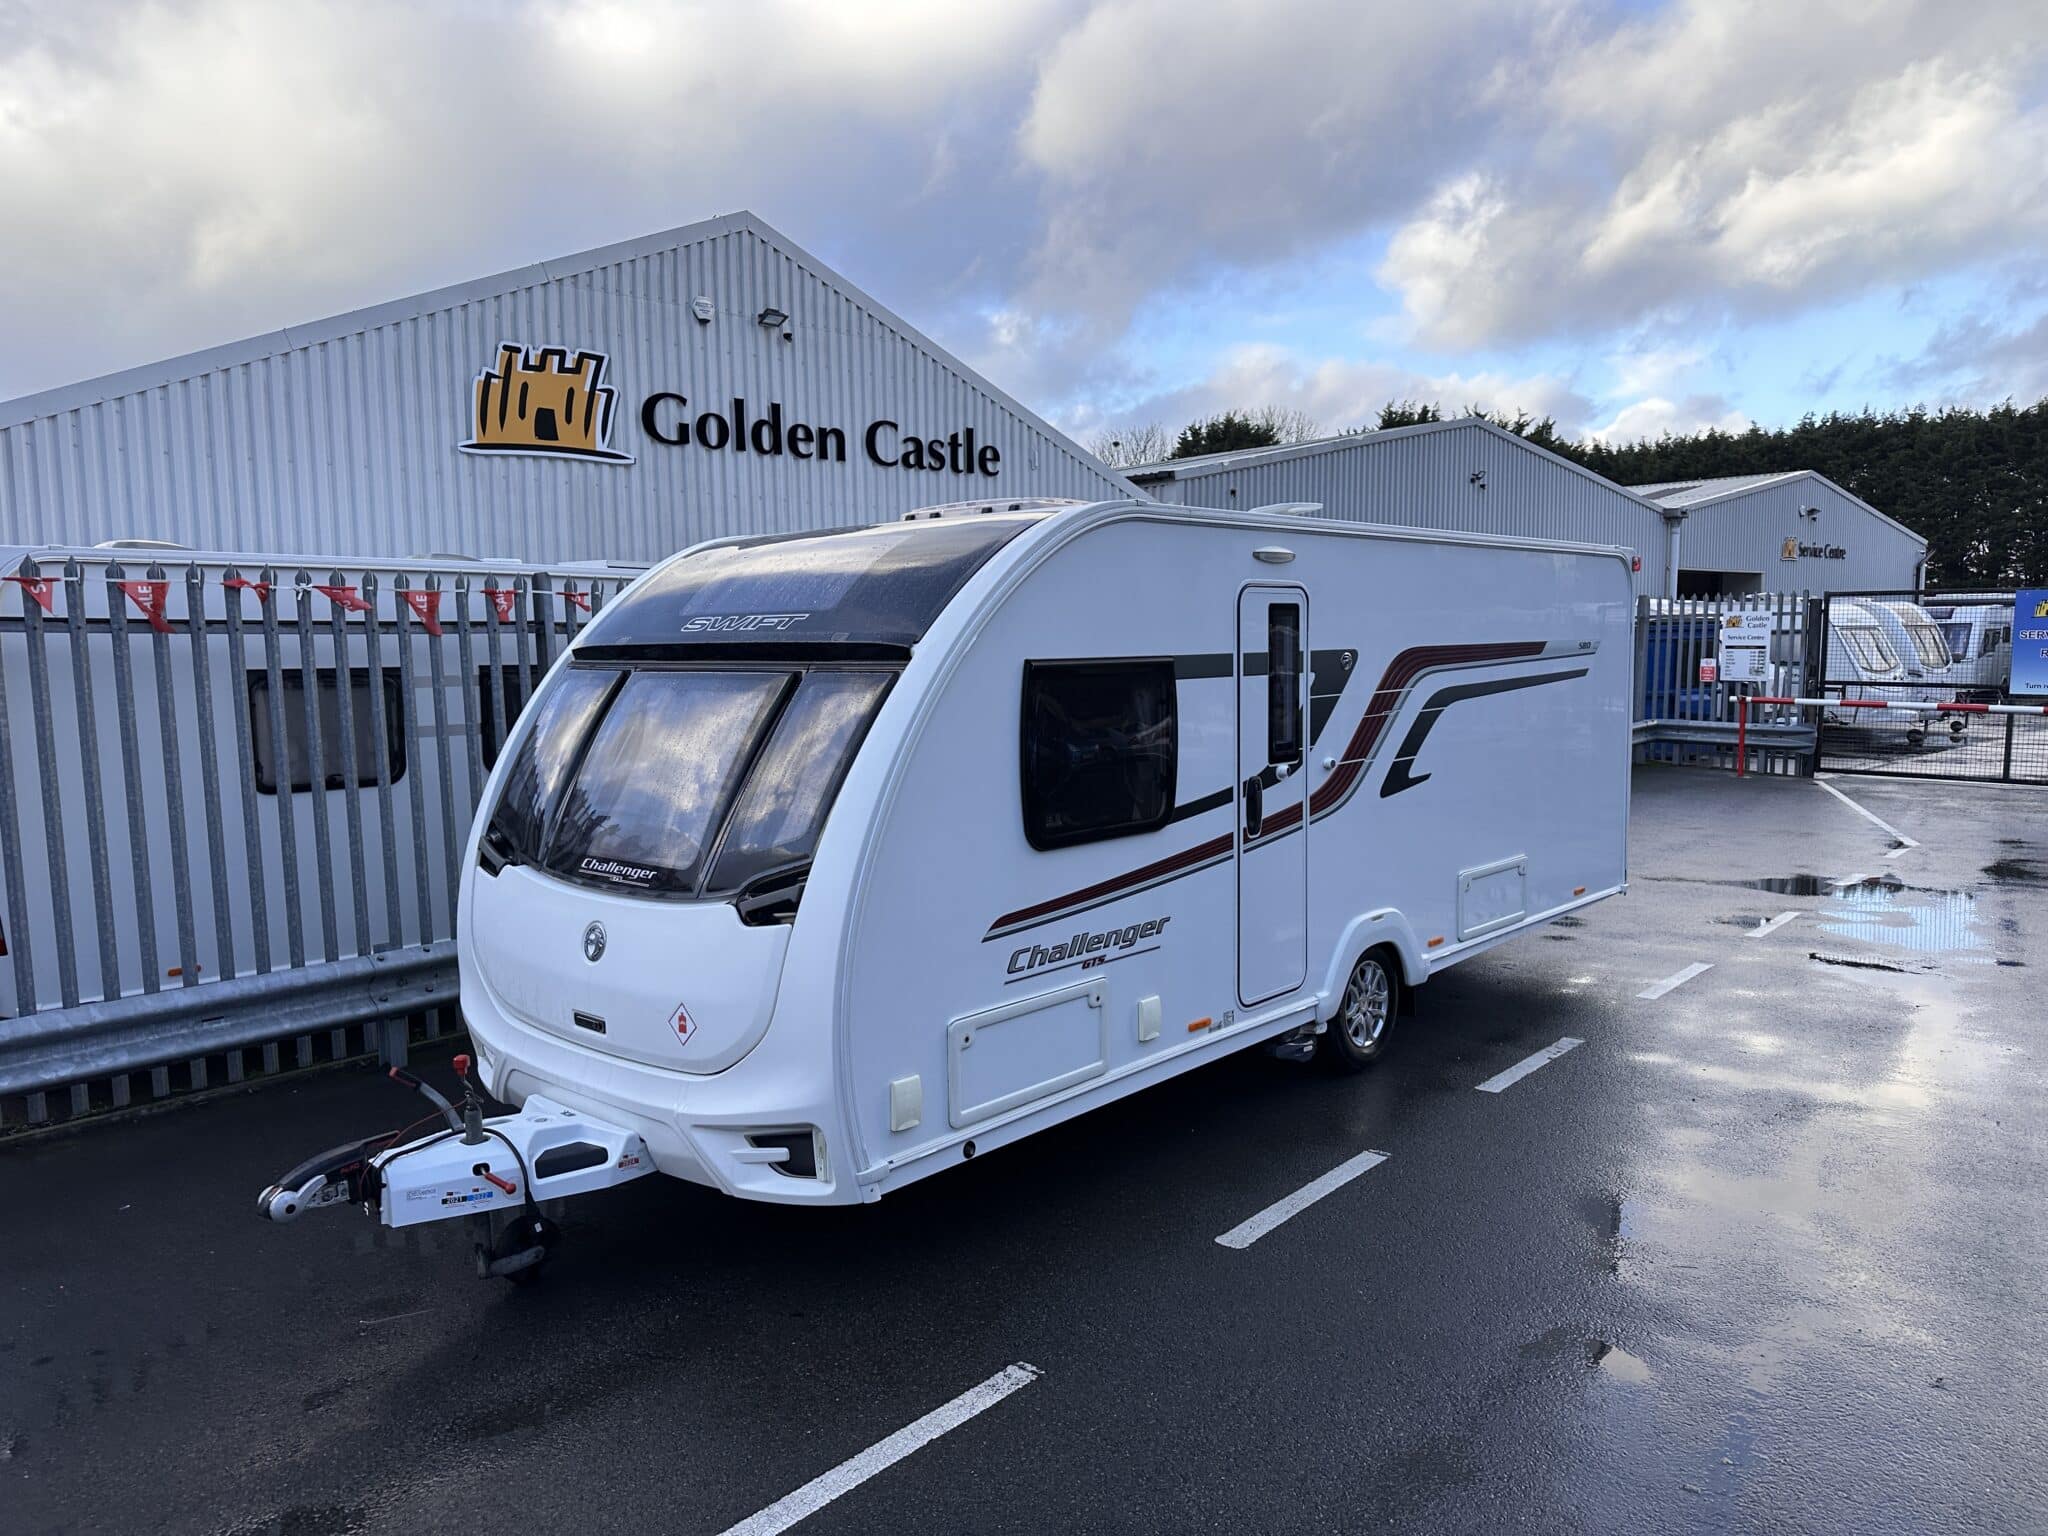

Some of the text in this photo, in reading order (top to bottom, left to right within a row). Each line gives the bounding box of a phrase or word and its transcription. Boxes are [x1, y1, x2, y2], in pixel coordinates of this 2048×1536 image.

[641, 392, 1001, 477] Golden Castle
[1798, 542, 1846, 560] Service Centre
[681, 613, 810, 632] SWIFT
[2024, 682, 2042, 690] Turn
[580, 858, 658, 880] Challenger
[1007, 916, 1171, 975] Challenger
[1081, 954, 1107, 970] GTS
